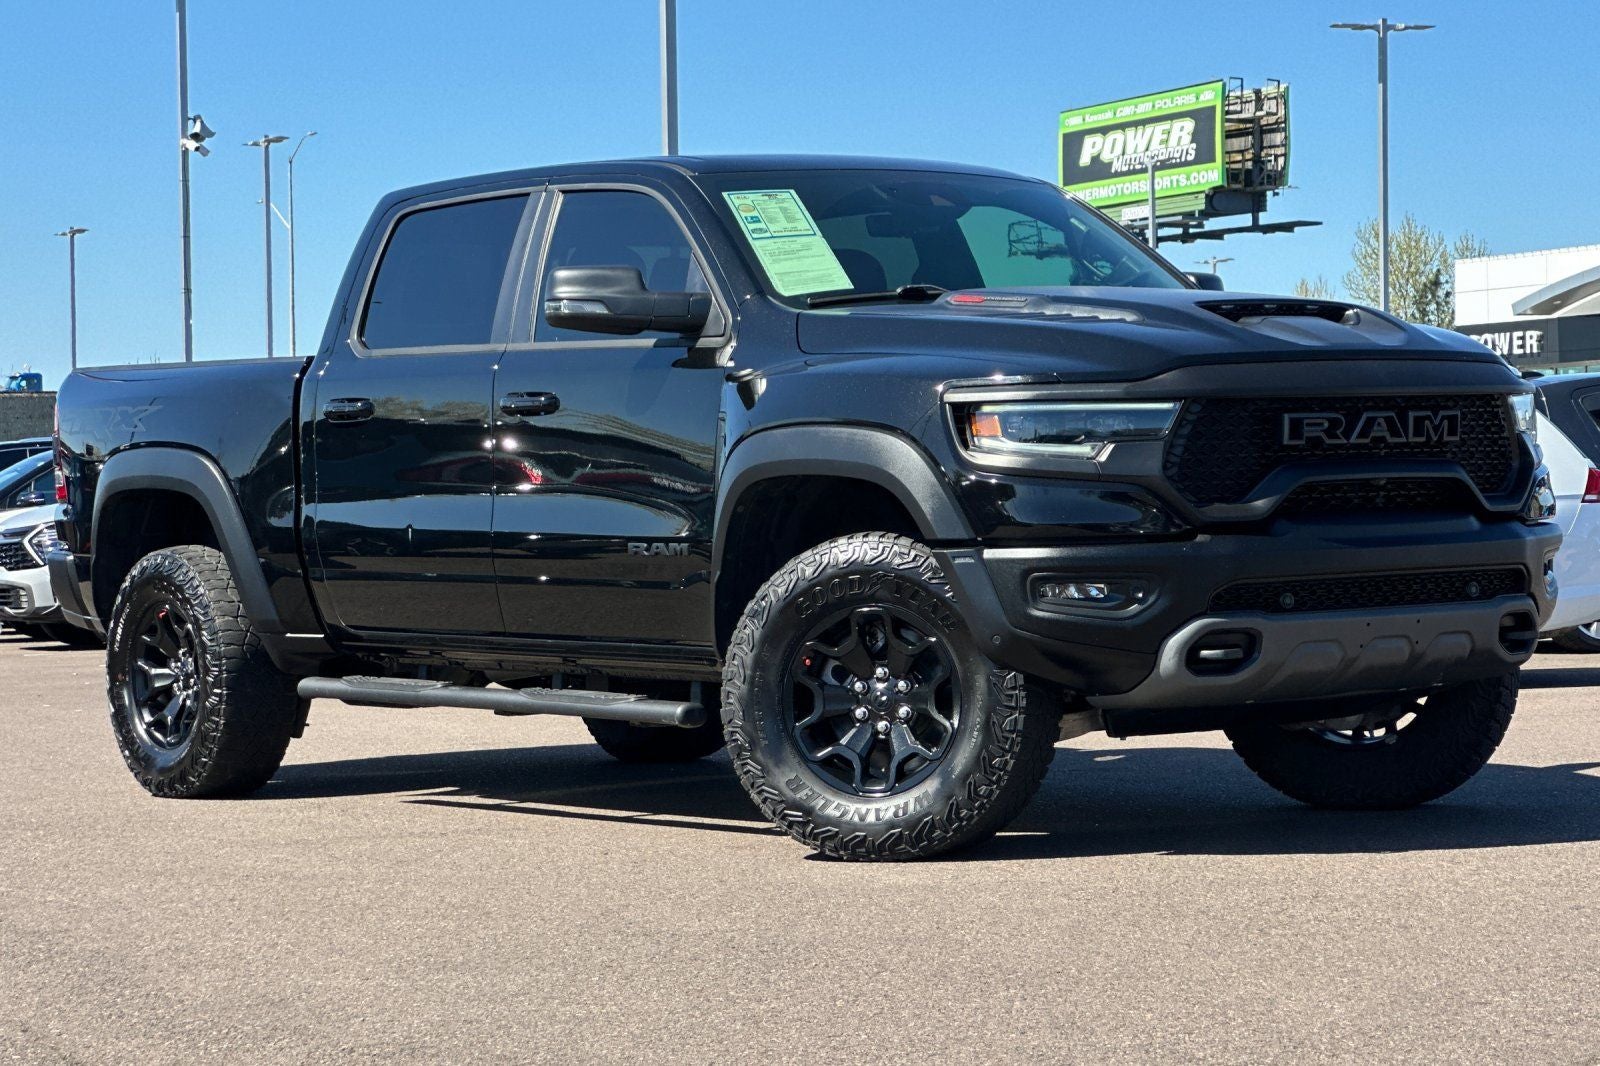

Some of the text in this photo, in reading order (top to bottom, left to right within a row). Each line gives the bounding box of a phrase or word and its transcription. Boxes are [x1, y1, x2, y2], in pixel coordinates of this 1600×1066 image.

[1154, 93, 1196, 110] POLARIS
[1079, 117, 1195, 167] POWER
[1282, 410, 1461, 445] RAM
[627, 542, 690, 556] RAM
[785, 774, 935, 824] WRANGLER
